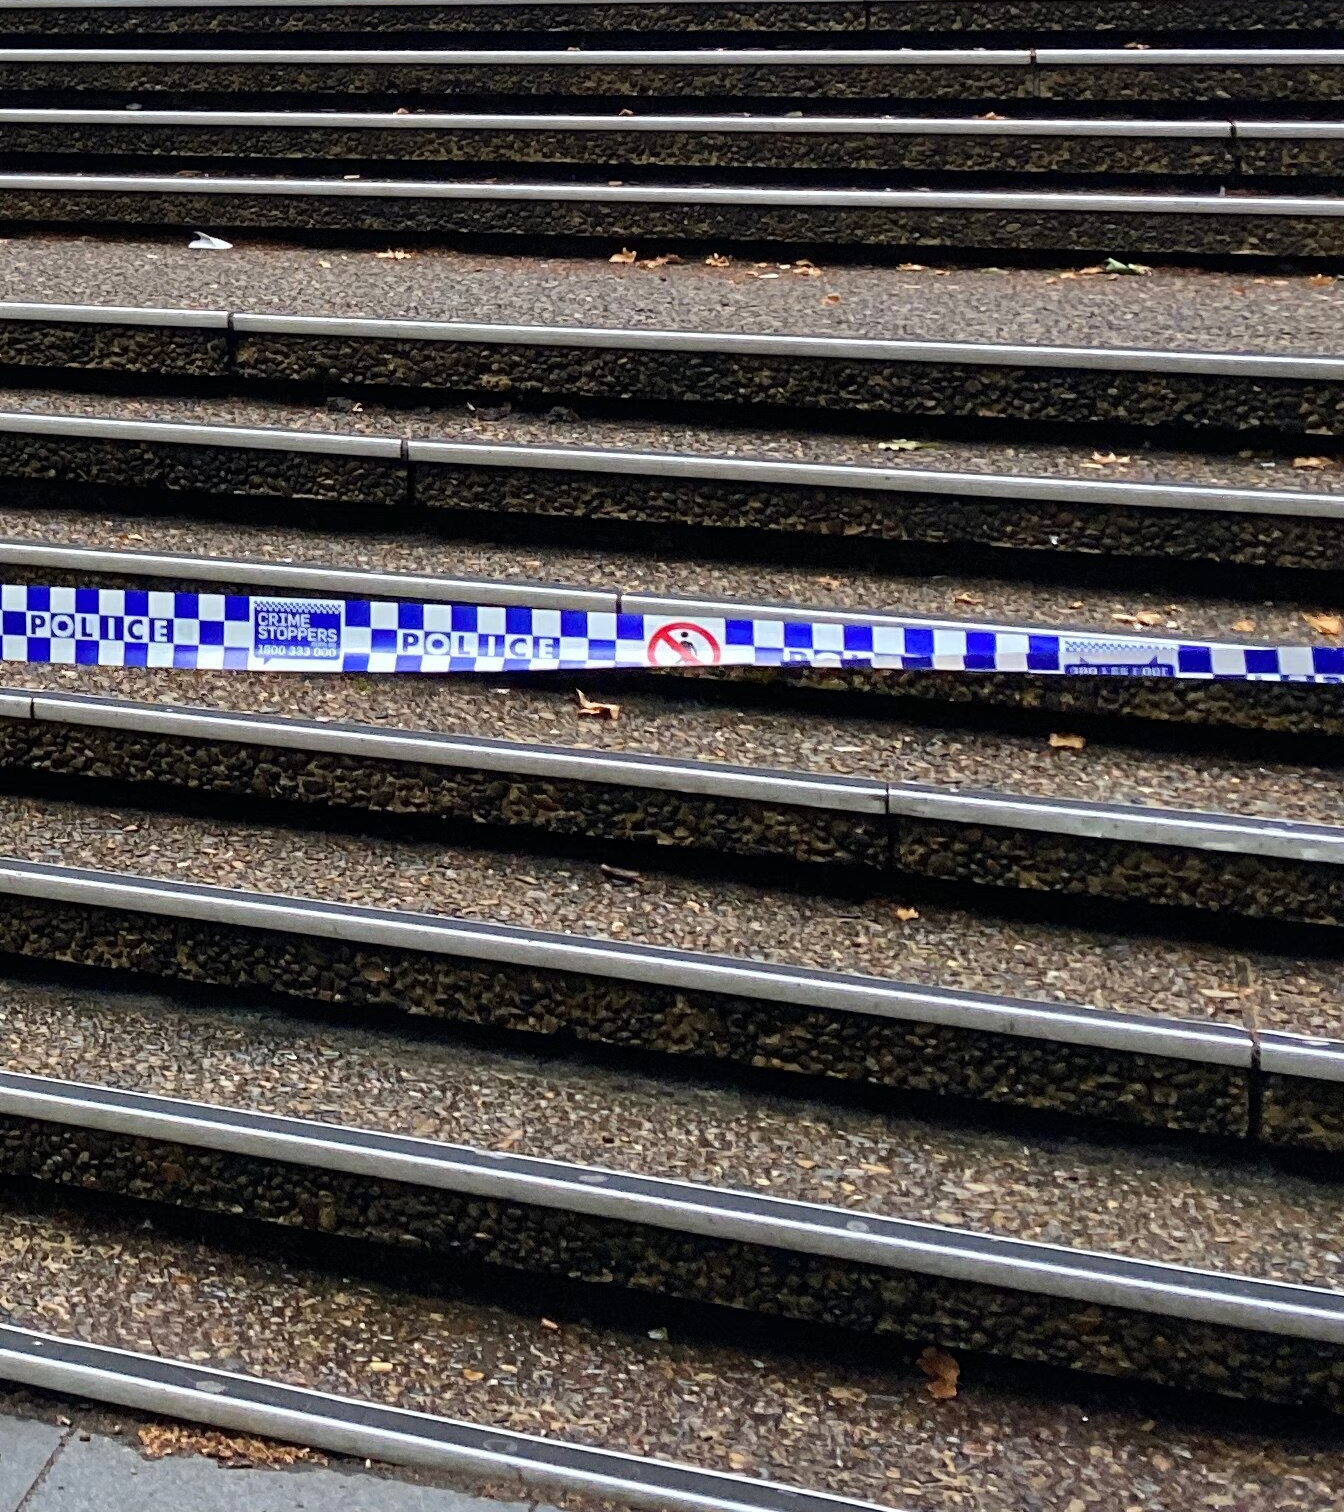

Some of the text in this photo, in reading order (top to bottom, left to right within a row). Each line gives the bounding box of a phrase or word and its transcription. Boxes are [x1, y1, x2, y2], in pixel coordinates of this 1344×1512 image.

[30, 614, 168, 642] POLICE
[257, 611, 311, 628] CRIME
[257, 625, 338, 643] STOPPERS
[258, 644, 337, 658] 1800 333 000
[402, 632, 555, 659] POLICE
